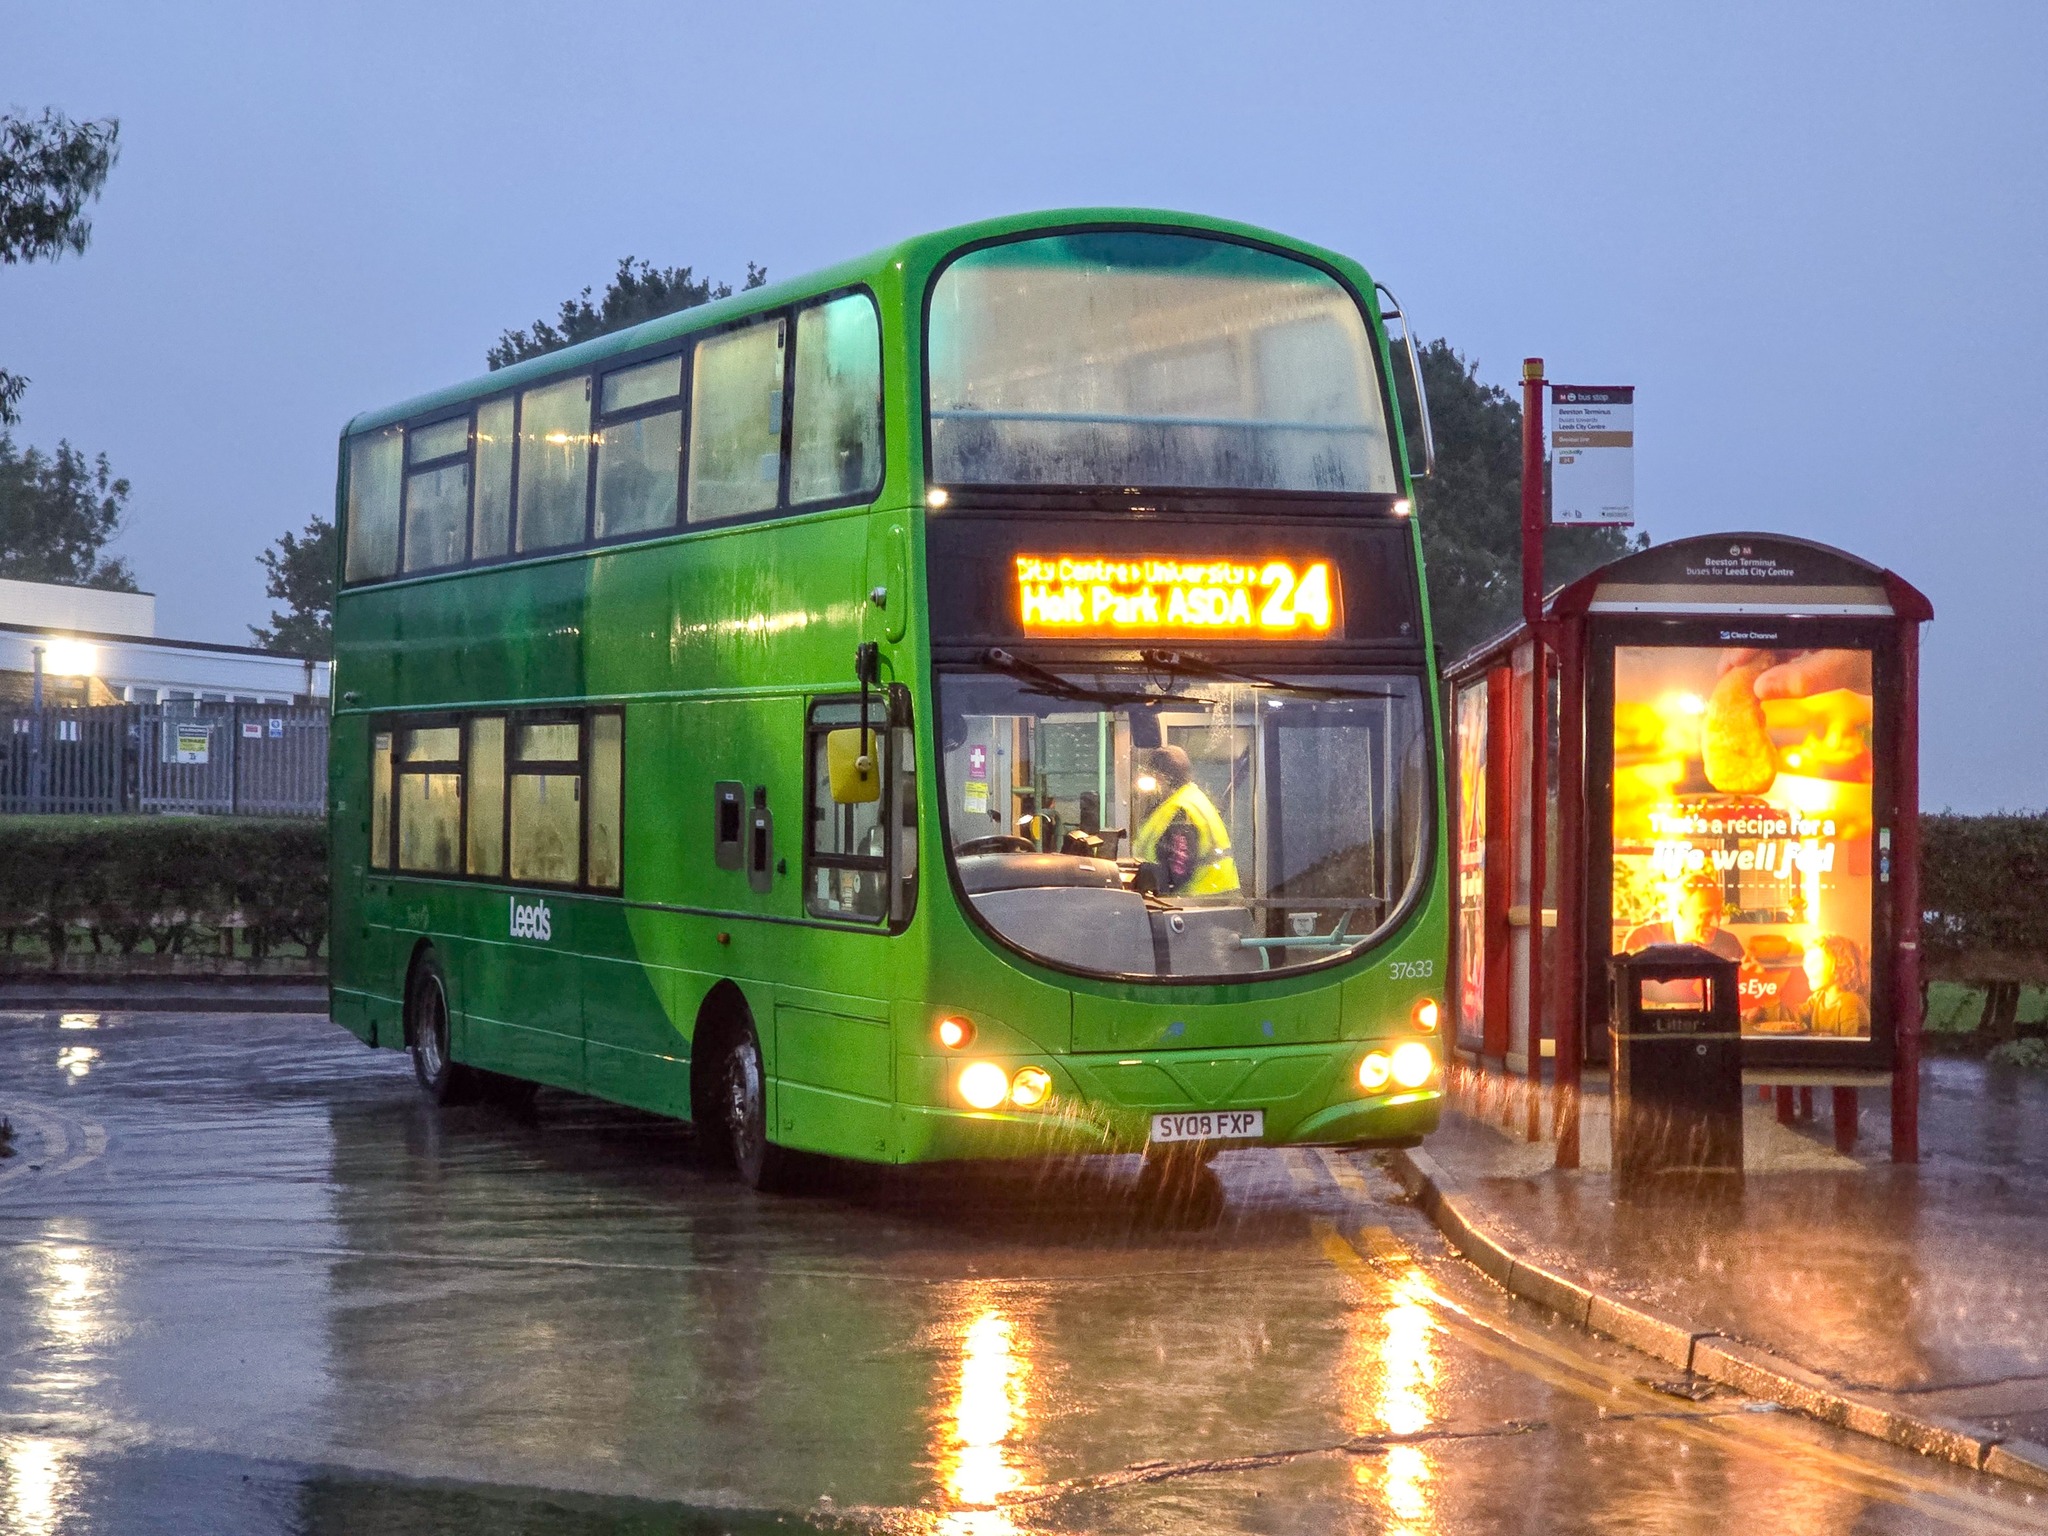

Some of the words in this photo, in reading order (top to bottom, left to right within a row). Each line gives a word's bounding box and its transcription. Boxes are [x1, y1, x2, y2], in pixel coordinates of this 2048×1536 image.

[1592, 394, 1609, 402] stop
[1059, 558, 1129, 583] Centre
[1144, 560, 1246, 586] University
[1686, 567, 1710, 576] buses
[1712, 567, 1723, 576] for
[1725, 567, 1748, 576] Leeds
[1750, 567, 1766, 577] City
[1768, 567, 1795, 577] Centre
[1705, 558, 1738, 566] Beeston
[1740, 558, 1777, 567] Terminus
[1022, 584, 1086, 623] Holt
[1091, 584, 1160, 624] Park
[1166, 586, 1253, 625] ASDA
[1258, 562, 1332, 628] 24
[1731, 631, 1749, 639] Clear
[1749, 631, 1778, 639] Channel
[1649, 813, 1708, 834] That's
[1711, 818, 1723, 834] a
[1727, 815, 1787, 839] recipe
[1790, 812, 1822, 836] for
[1822, 819, 1836, 836] a
[1711, 842, 1776, 872] well
[510, 896, 552, 941] Leeds
[1390, 960, 1433, 980] 37633
[1738, 979, 1777, 999] sEye
[1656, 1018, 1700, 1032] Litter
[1160, 1115, 1212, 1138] SV08
[1217, 1113, 1255, 1135] FXP
